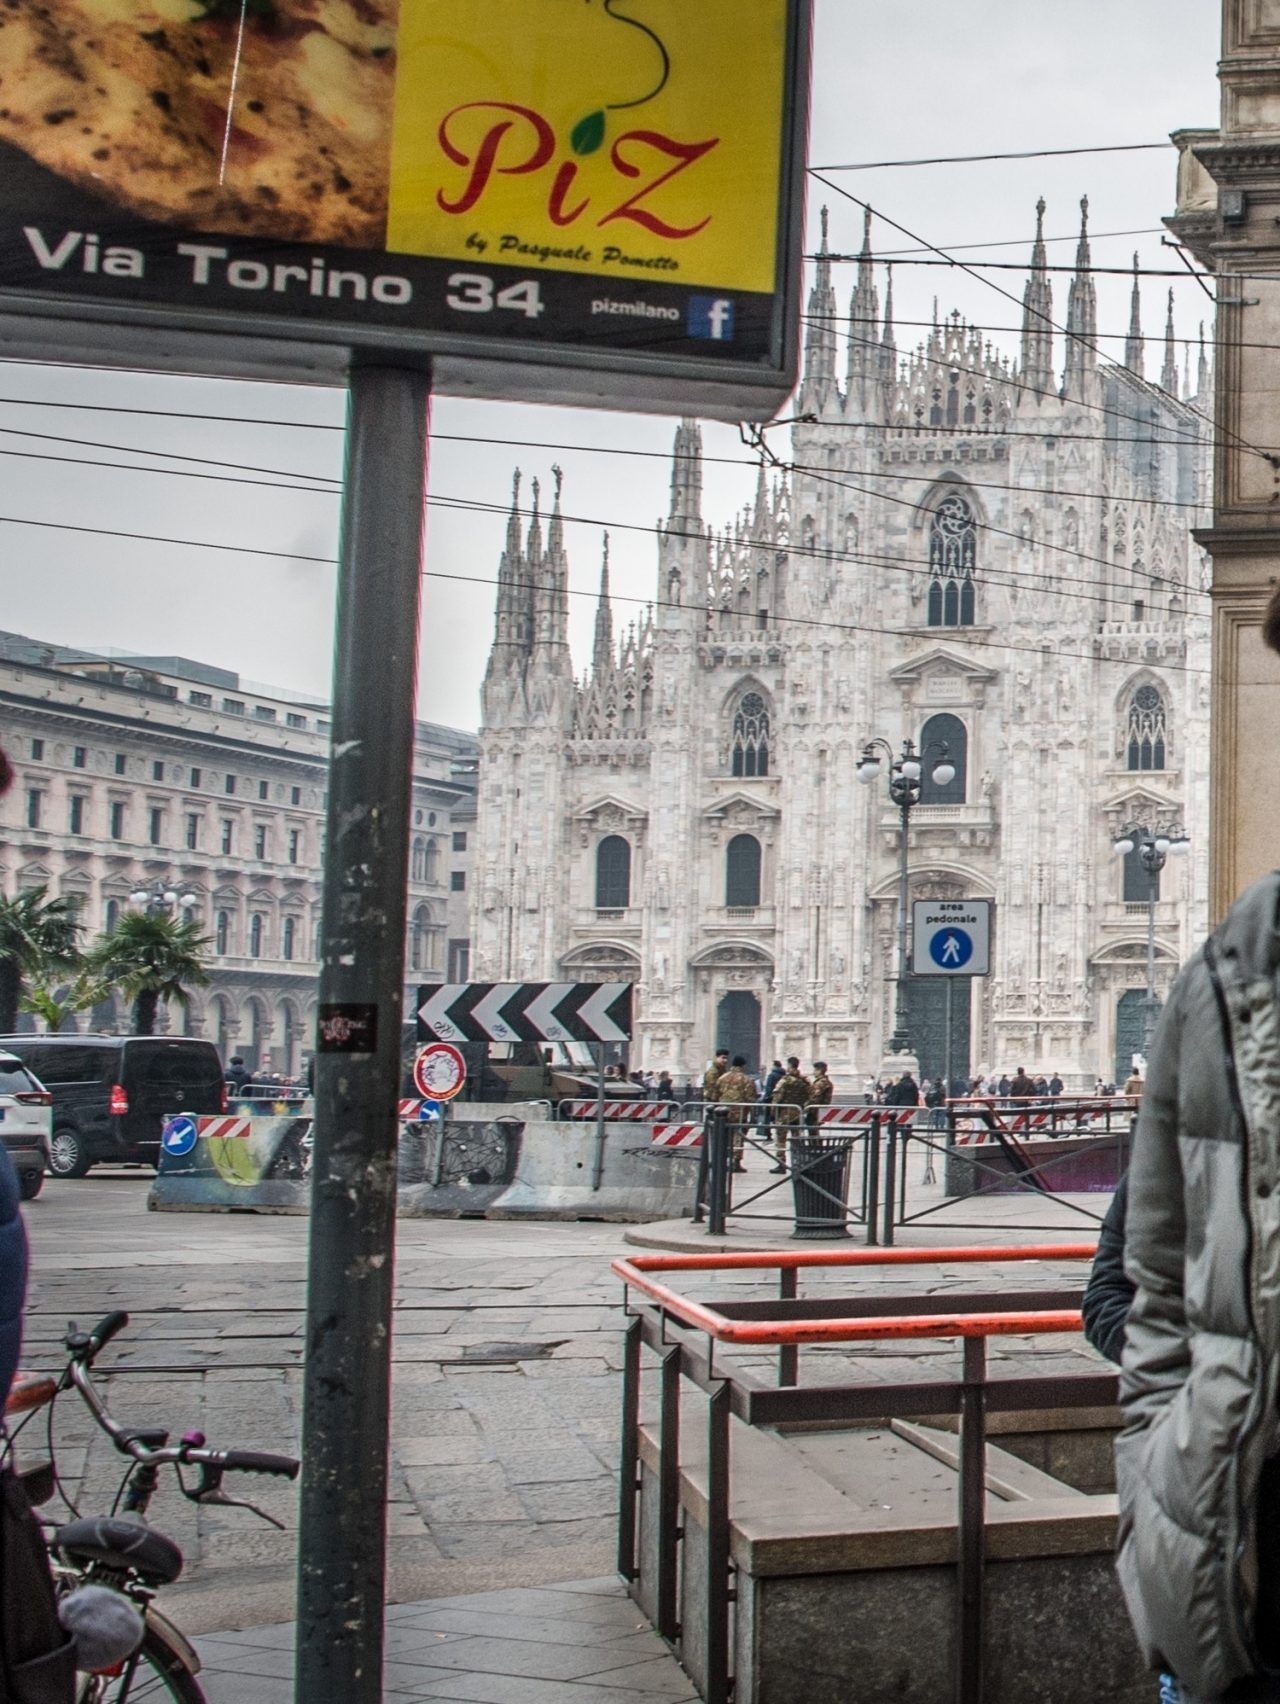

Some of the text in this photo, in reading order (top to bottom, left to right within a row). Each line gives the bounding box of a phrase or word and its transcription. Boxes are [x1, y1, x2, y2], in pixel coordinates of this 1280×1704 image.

[465, 233, 488, 252] by
[499, 234, 591, 262] Pasquale
[23, 226, 545, 318] Via Torino 34
[591, 298, 680, 321] pizmilano
[940, 903, 964, 911] area
[926, 914, 977, 925] pedonale
